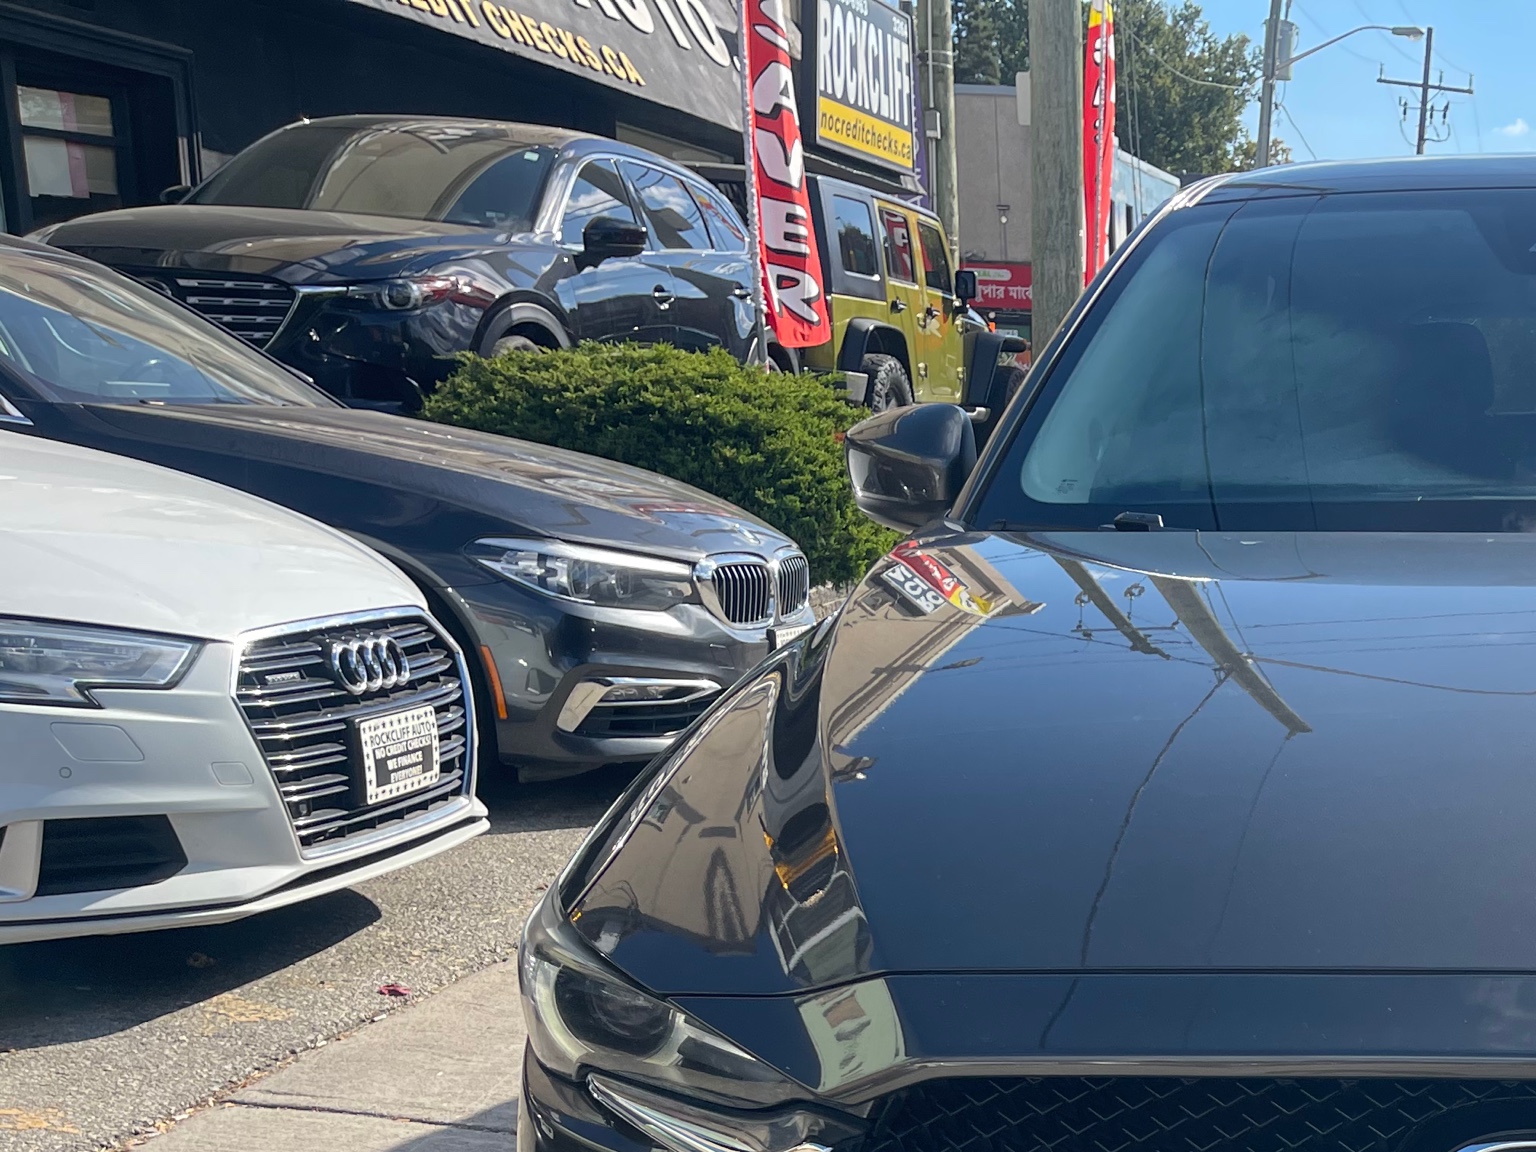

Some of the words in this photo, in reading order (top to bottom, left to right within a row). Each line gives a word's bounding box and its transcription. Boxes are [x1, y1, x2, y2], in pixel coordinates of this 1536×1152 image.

[819, 0, 911, 127] ROCKCLIFF
[820, 110, 912, 160] nocreditchecks.ca
[369, 726, 410, 748] ROCKCLIFF
[412, 721, 431, 736] AUTO
[375, 747, 386, 760] NO
[386, 758, 398, 771] WE
[398, 750, 423, 768] FINANCE
